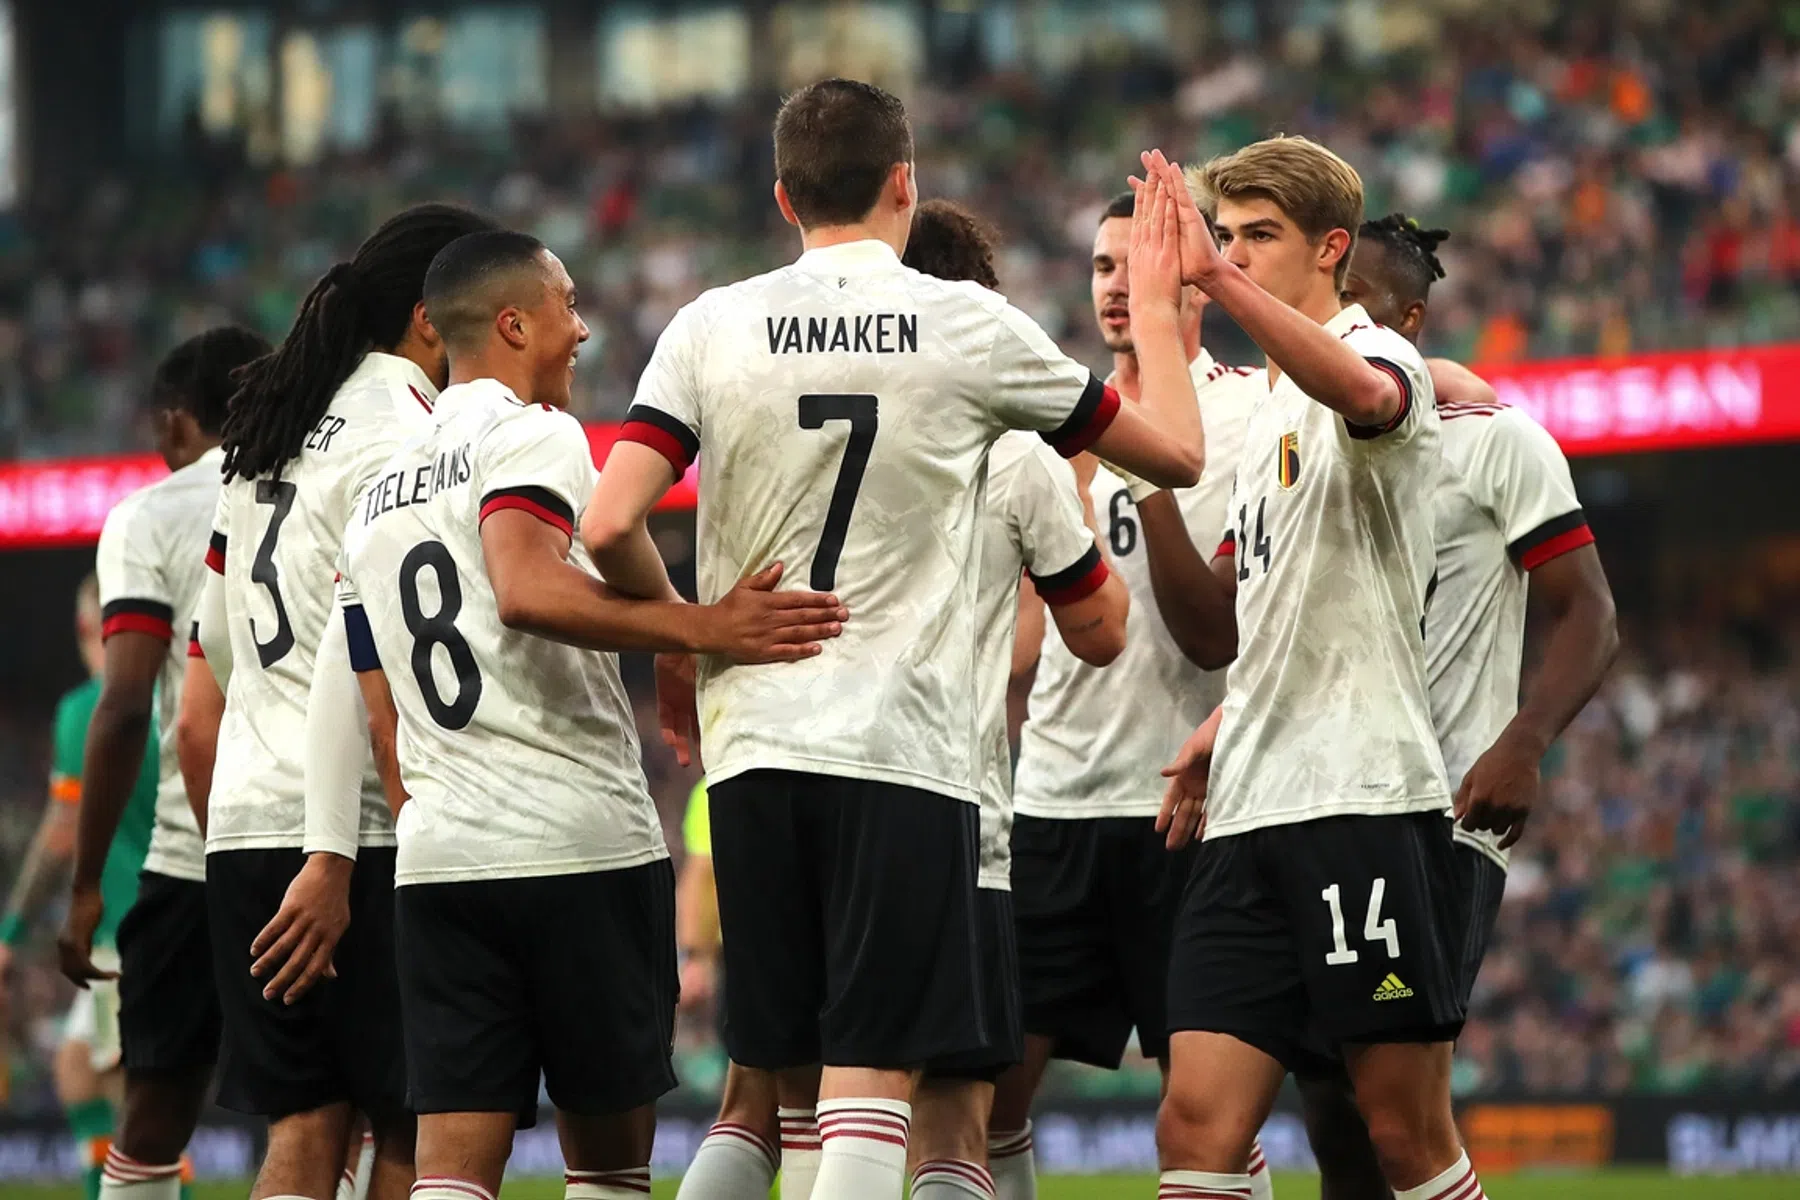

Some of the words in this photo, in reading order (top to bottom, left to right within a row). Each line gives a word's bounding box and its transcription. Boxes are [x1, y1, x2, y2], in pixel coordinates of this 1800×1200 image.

[766, 313, 918, 354] VANAKEN
[305, 415, 347, 452] ER
[364, 442, 471, 527] TIELEANS
[798, 394, 878, 591] 7
[1109, 488, 1137, 557] 6
[249, 479, 297, 669] 3
[1238, 496, 1271, 582] 14
[399, 540, 483, 731] 8
[1321, 877, 1401, 966] 14
[1372, 987, 1414, 1001] adidas
